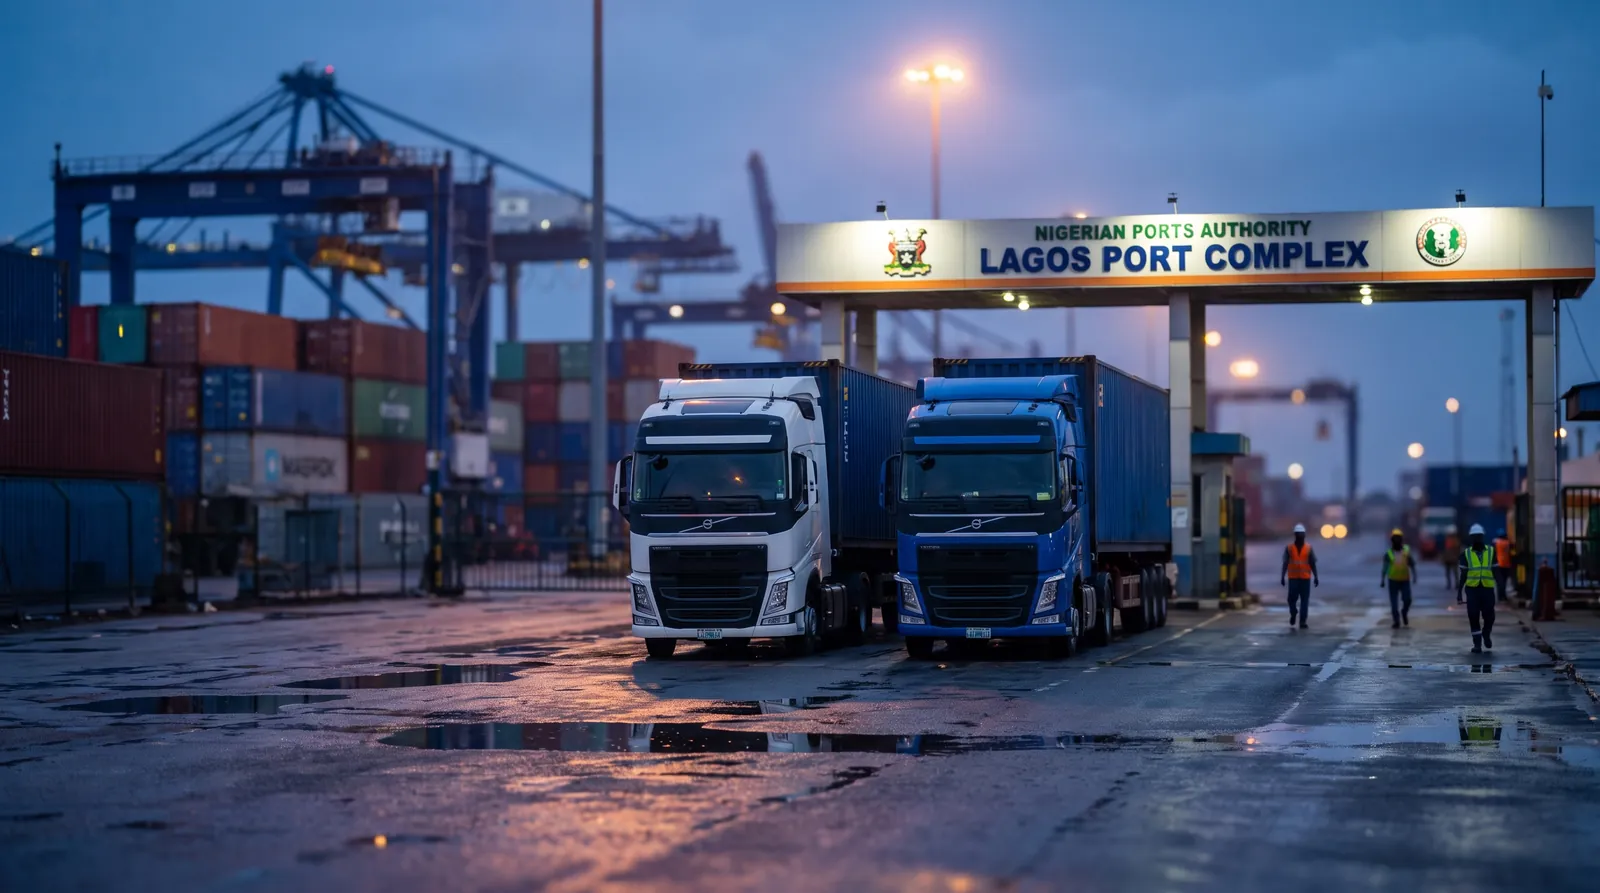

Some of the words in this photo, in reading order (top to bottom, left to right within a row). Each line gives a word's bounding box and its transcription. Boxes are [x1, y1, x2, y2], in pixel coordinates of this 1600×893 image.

[1035, 224, 1126, 241] NIGERIAN
[1132, 223, 1195, 239] PORTS
[1200, 220, 1312, 238] AUTHORITY
[980, 245, 1091, 274] LAGOS
[1102, 244, 1192, 272] PORT
[1204, 240, 1370, 271] COMPLEX
